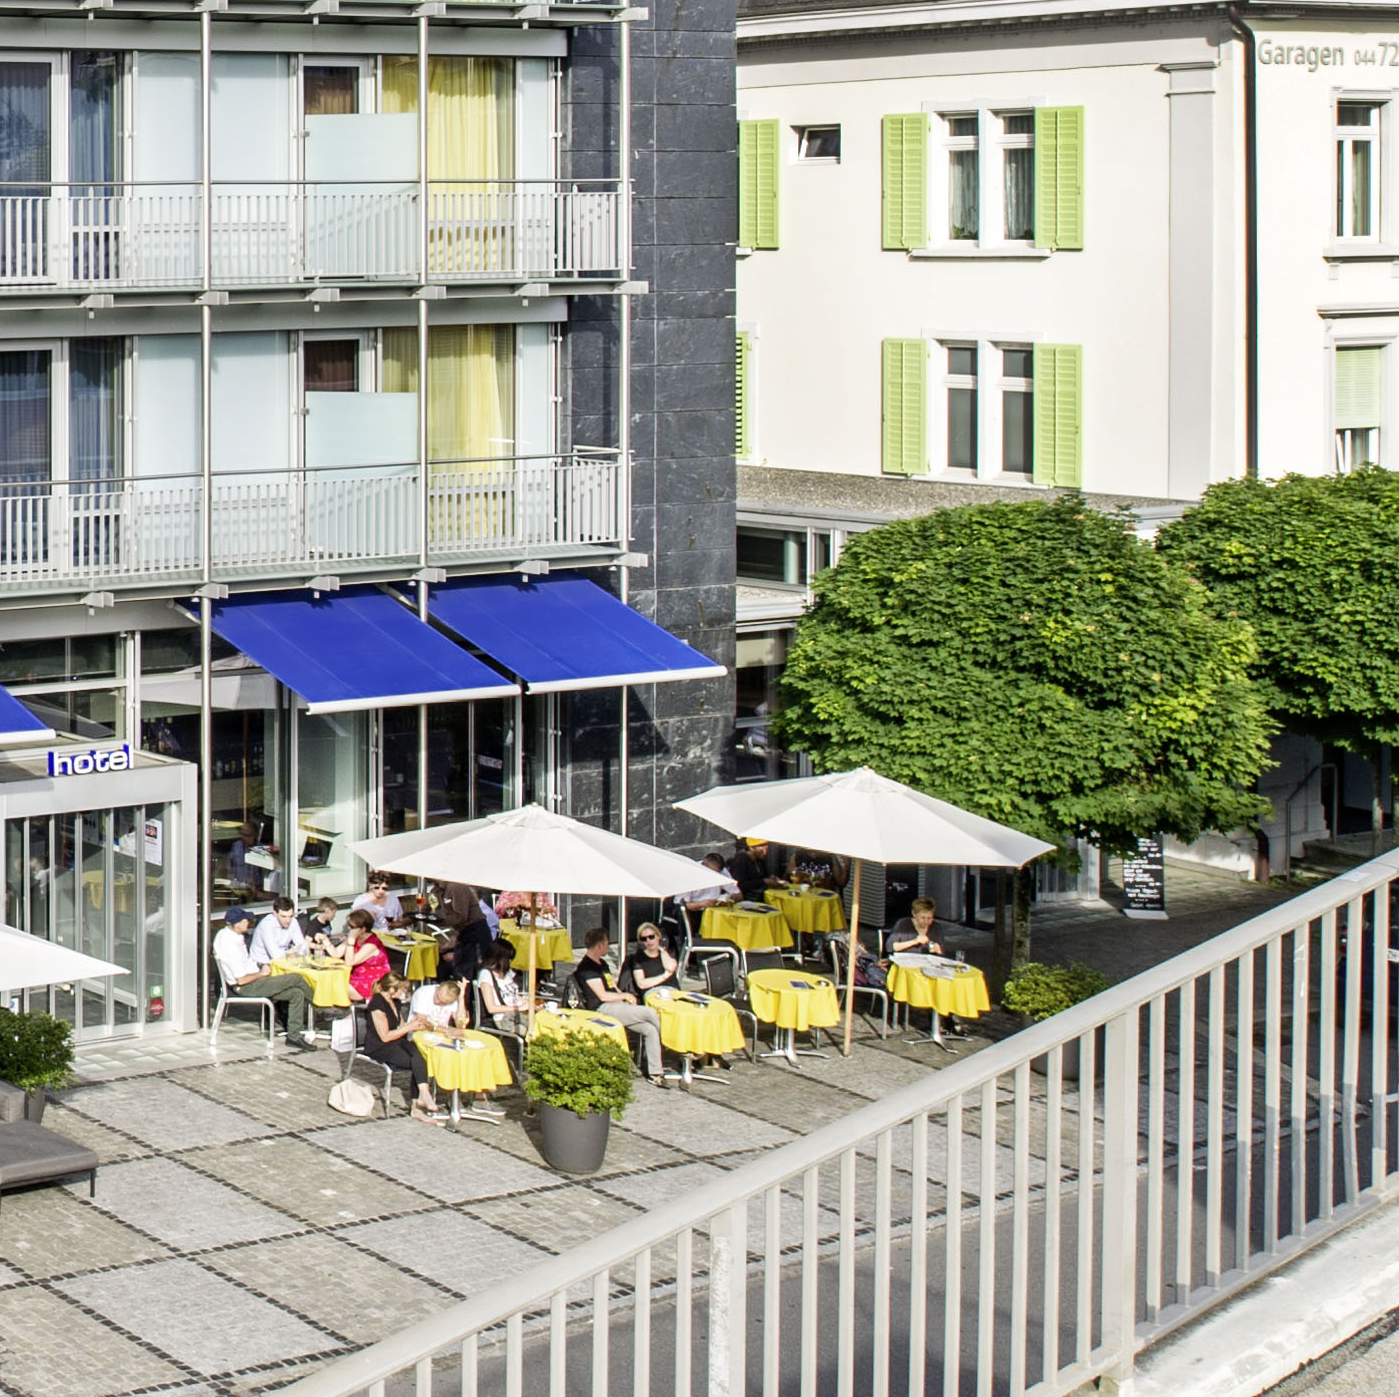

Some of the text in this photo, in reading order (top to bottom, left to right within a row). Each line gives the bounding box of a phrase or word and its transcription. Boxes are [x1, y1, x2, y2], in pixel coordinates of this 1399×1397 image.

[1258, 39, 1344, 73] Garagen
[1354, 49, 1376, 66] 044
[47, 744, 134, 776] hotel
